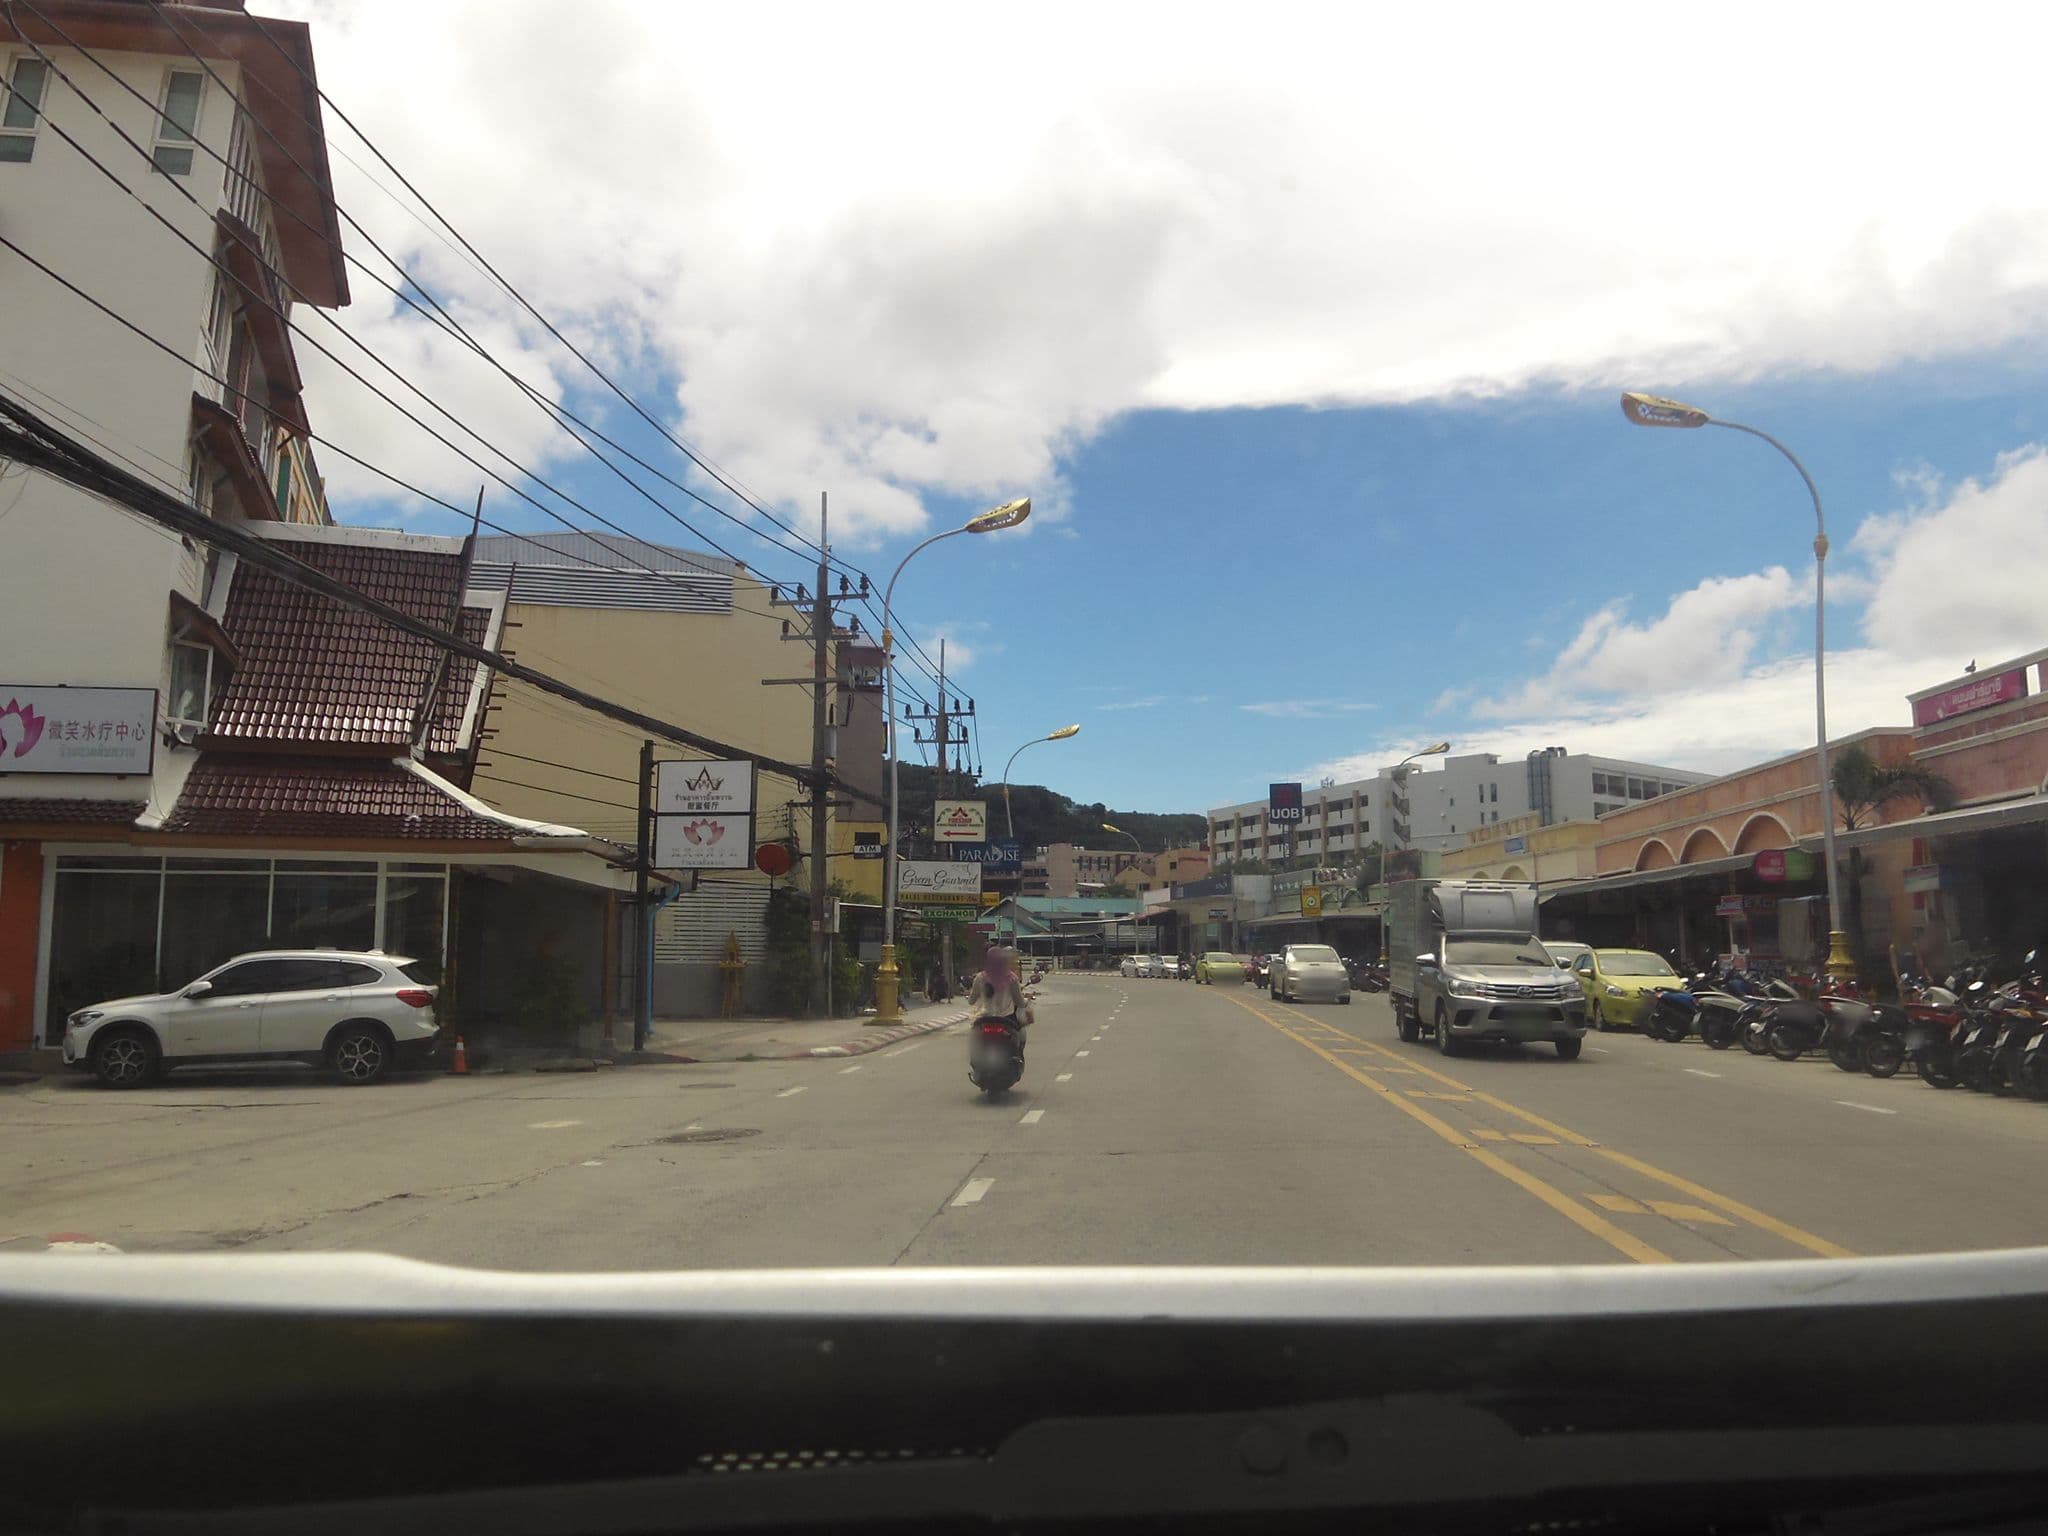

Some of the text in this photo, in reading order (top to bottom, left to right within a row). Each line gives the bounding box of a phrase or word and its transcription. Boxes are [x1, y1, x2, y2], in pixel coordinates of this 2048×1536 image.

[48, 720, 146, 742] 微笑水疗中心
[1271, 808, 1300, 819] UOB
[959, 846, 1020, 861] PARADISE
[901, 869, 933, 889] Green
[923, 909, 975, 917] EXCHANGE
